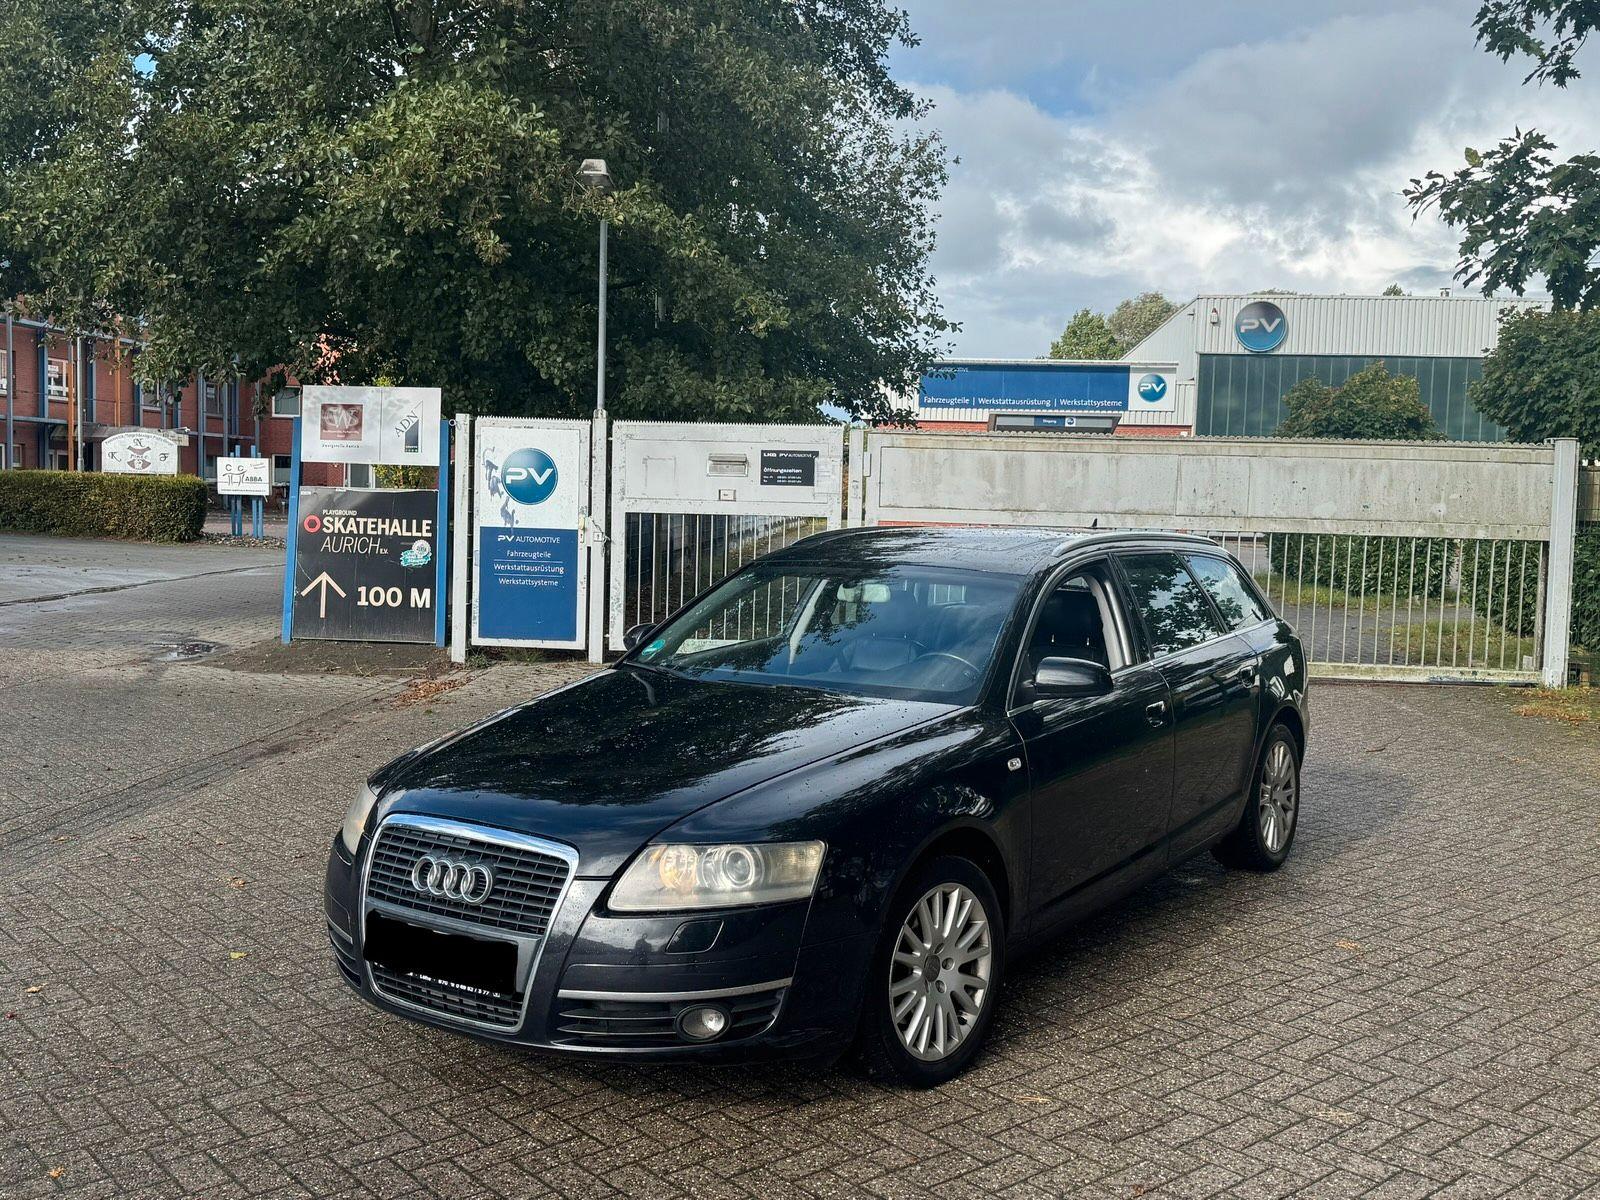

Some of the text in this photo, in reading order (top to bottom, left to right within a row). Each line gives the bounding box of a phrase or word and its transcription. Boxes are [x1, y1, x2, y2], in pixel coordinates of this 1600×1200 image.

[1240, 318, 1281, 333] PV
[1139, 382, 1165, 393] PV
[923, 396, 1122, 407] Fahrzeugteile Werkstattausrüstung Werkstattsysteme
[394, 410, 419, 438] ADN
[505, 467, 553, 485] PV
[322, 516, 432, 537] SKATEHALLE
[320, 536, 380, 554] AURICH
[516, 536, 560, 544] AUTOMOTIVE
[506, 550, 552, 559] Fahrzeugteile
[493, 563, 565, 574] Werkstattausrüstung
[498, 577, 559, 588] Werkstattsysteme
[357, 586, 431, 608] 100 M
